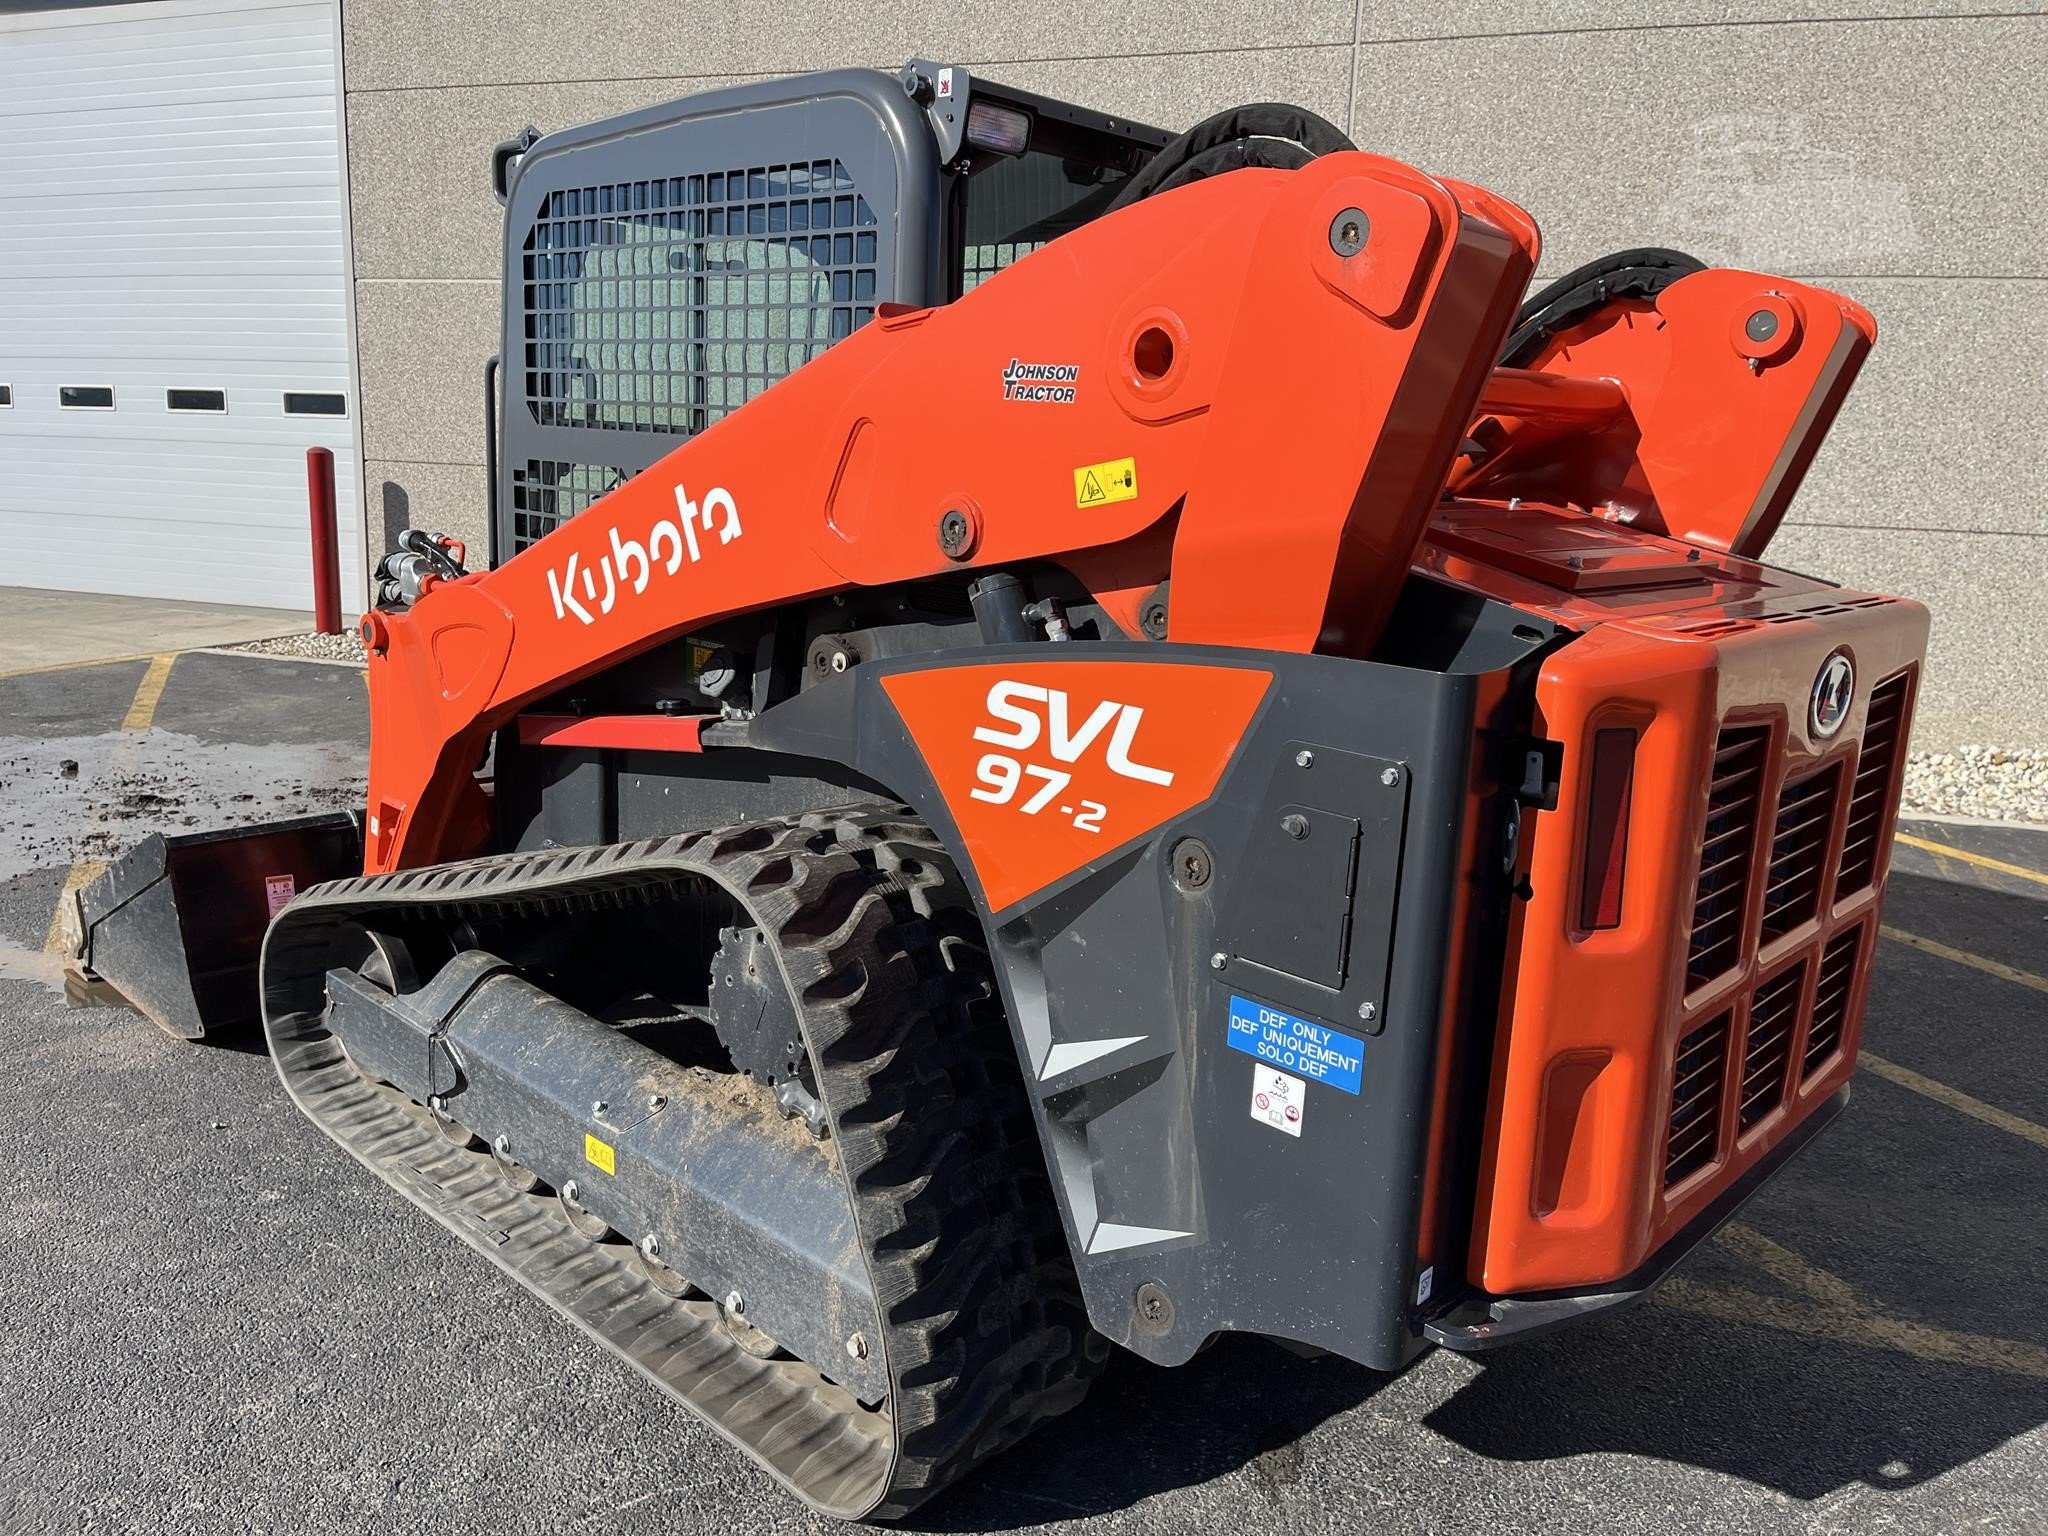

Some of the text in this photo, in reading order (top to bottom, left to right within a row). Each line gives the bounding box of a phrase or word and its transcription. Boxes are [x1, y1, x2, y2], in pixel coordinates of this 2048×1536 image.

[1003, 359, 1079, 381] JOHNSON
[1004, 380, 1075, 402] TRACTOR
[547, 483, 743, 625] Kubota
[973, 680, 1175, 787] SVL
[1231, 1015, 1359, 1073] DEF UNIQUEMENT
[1259, 1009, 1331, 1046] DEF ONLY
[1257, 1042, 1328, 1077] SOLO DEF
